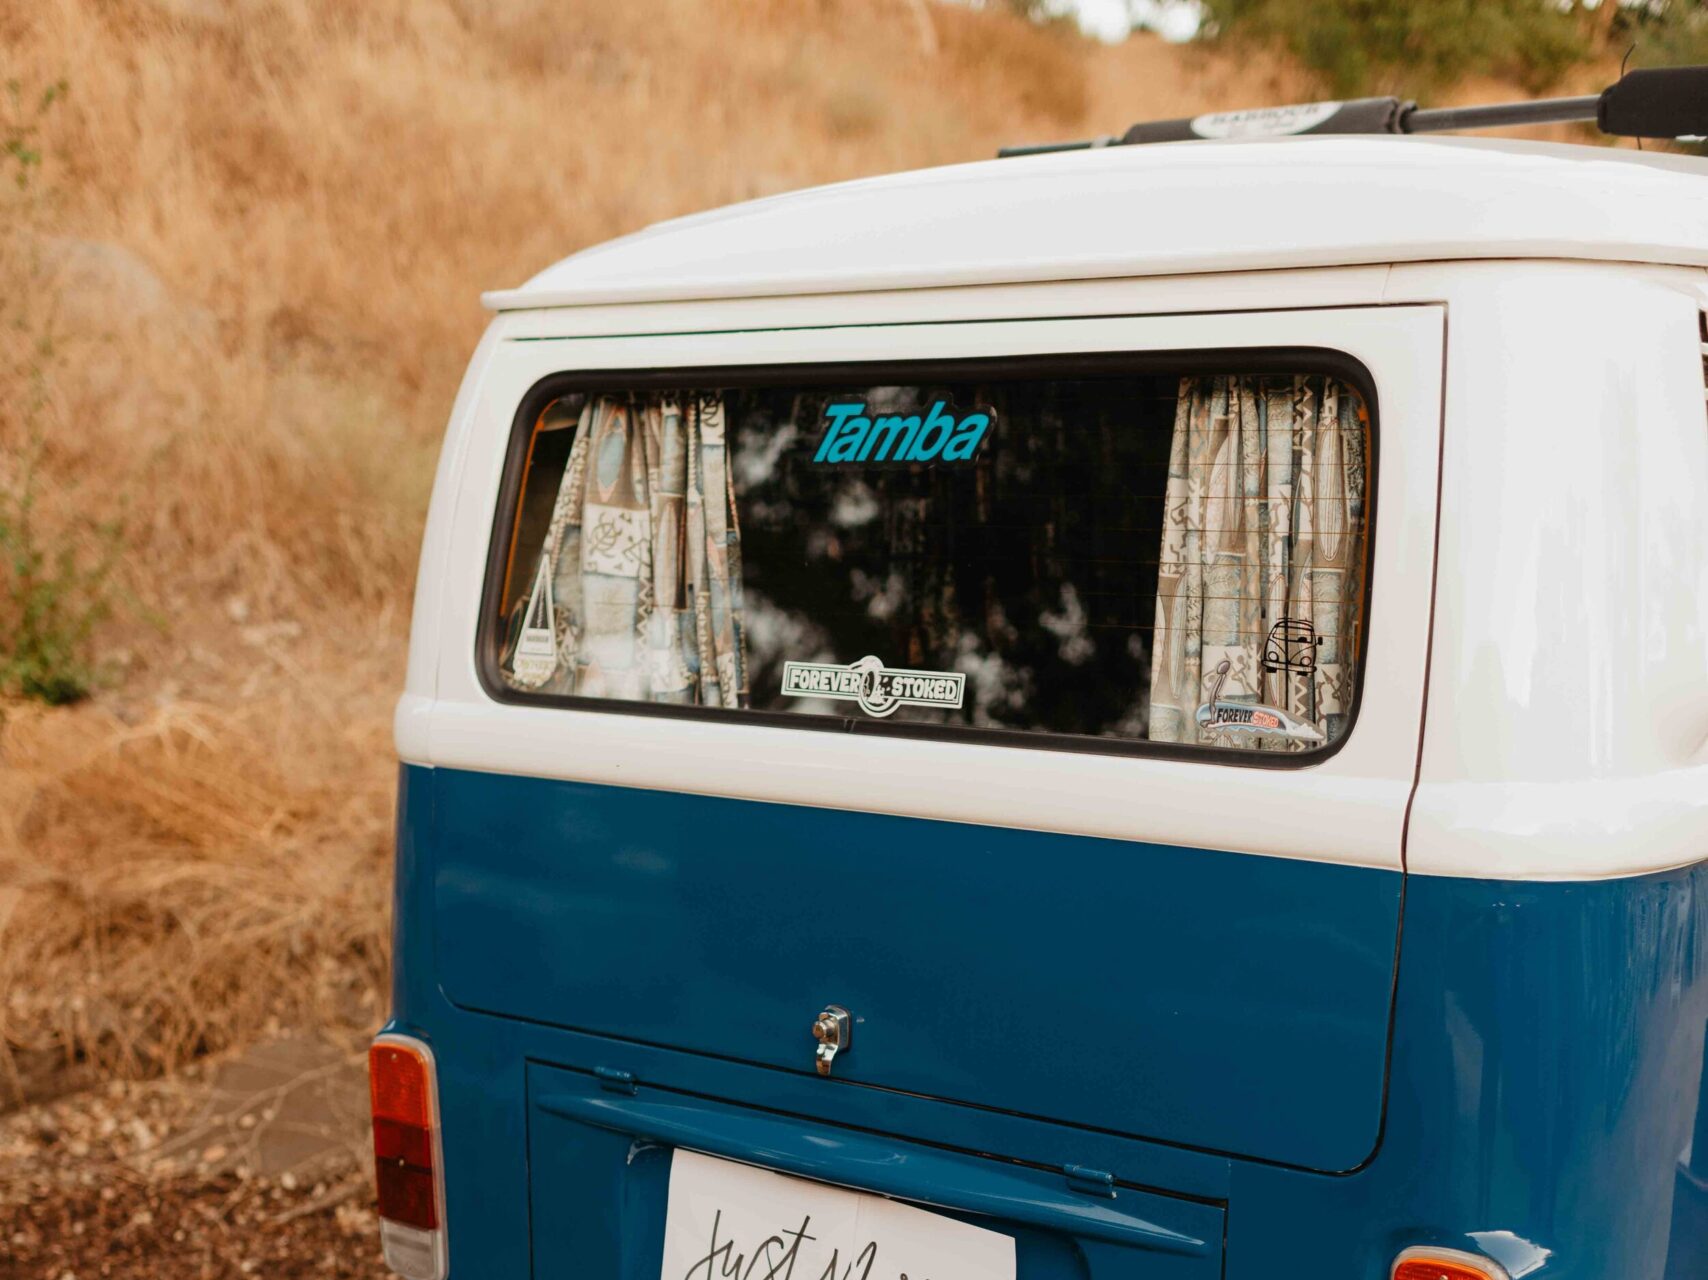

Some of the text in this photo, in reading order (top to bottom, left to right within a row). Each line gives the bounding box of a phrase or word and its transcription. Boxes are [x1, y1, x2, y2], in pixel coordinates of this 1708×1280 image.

[812, 401, 991, 463] Tamba
[789, 669, 958, 701] FOREVER STOKED
[1217, 708, 1253, 723] FOREVER
